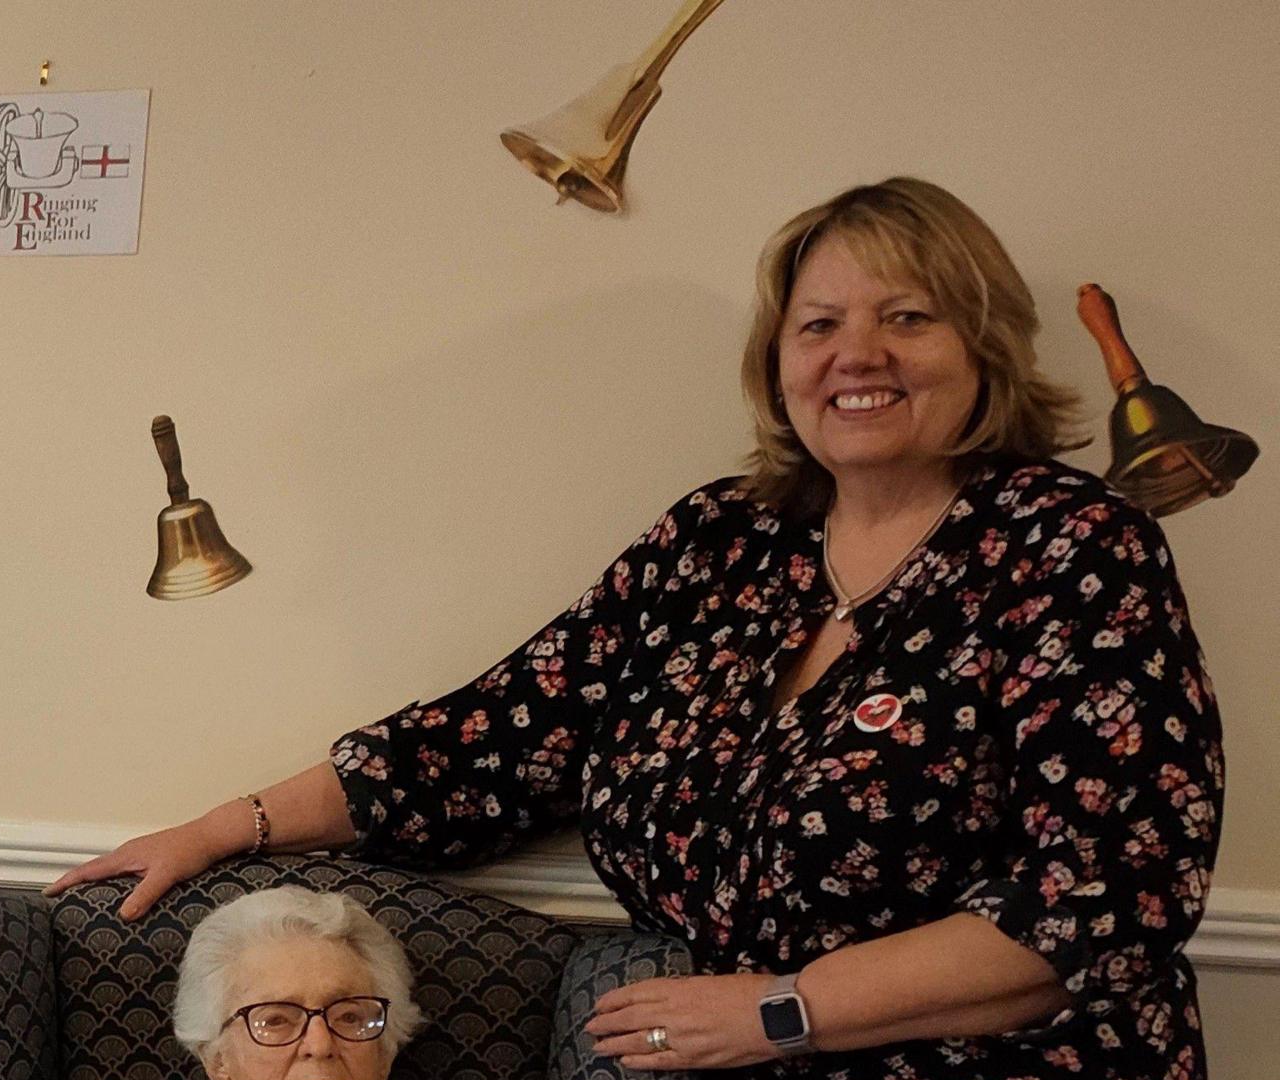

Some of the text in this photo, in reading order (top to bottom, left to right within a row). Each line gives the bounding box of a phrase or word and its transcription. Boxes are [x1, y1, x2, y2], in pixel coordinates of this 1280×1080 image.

[19, 191, 98, 221] Ringing
[46, 211, 79, 228] For
[12, 222, 91, 251] England
